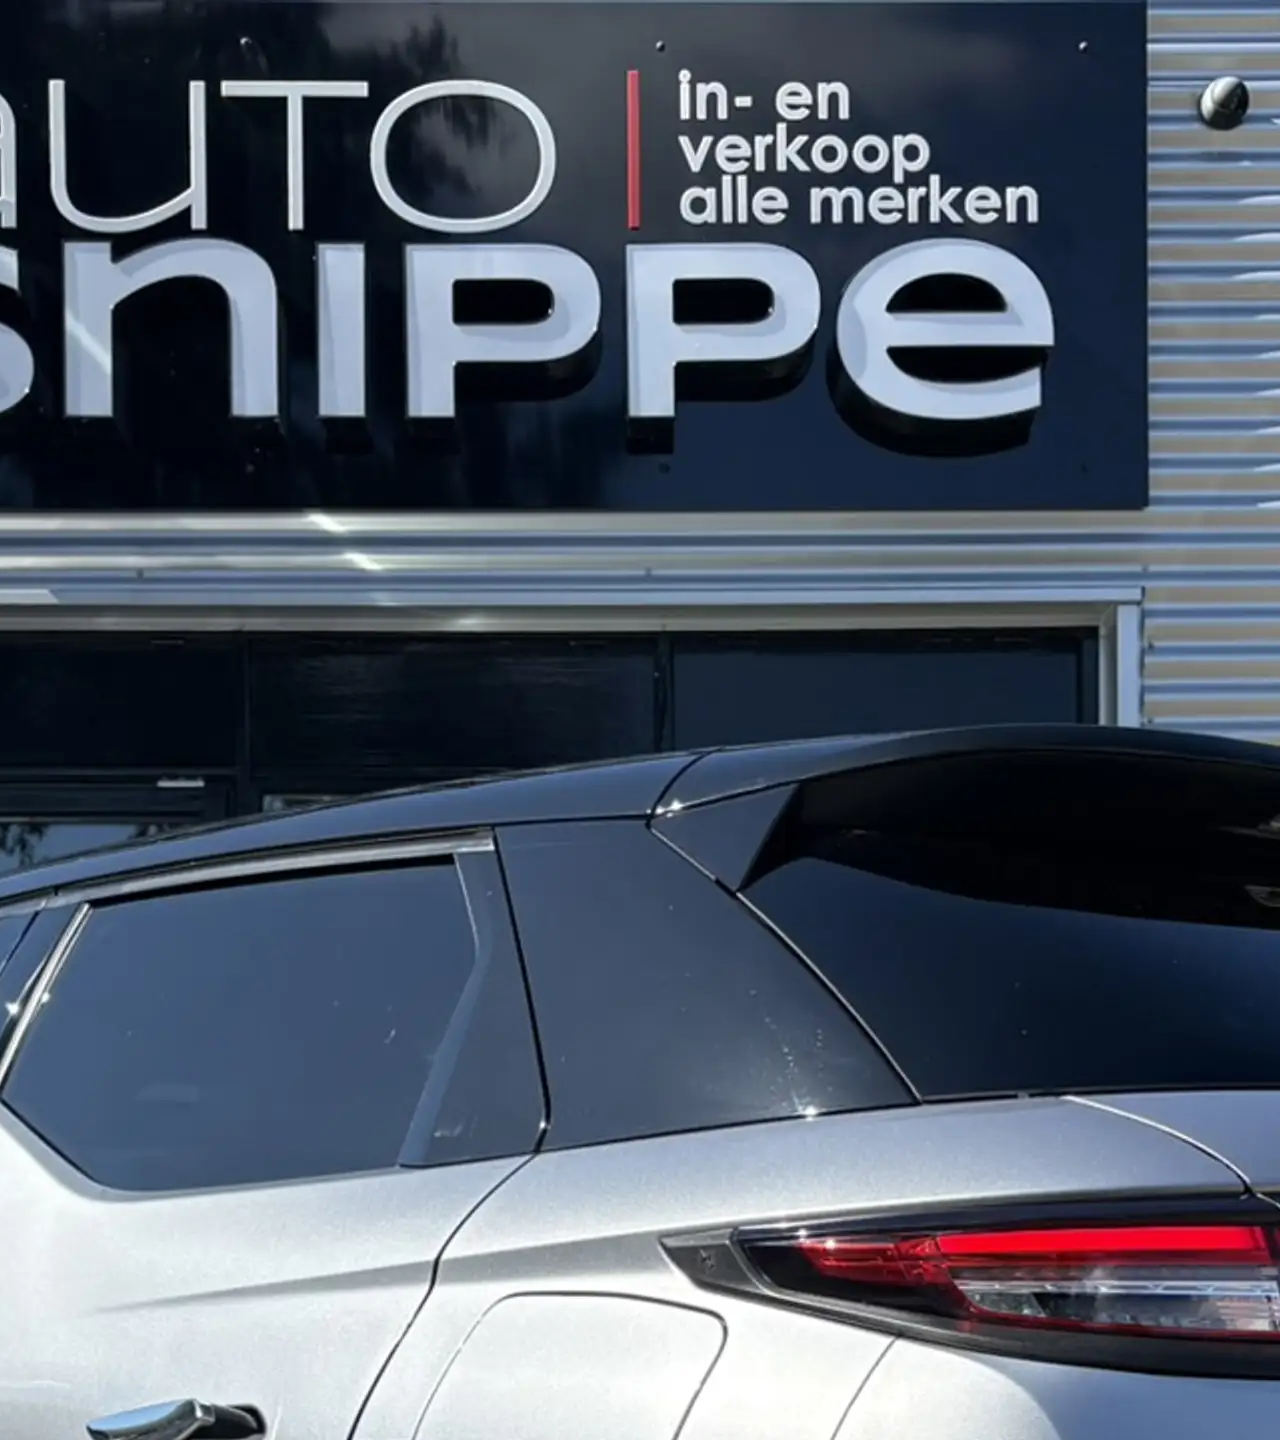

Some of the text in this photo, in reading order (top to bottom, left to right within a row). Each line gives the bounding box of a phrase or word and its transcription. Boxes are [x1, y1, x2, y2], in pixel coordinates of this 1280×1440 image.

[678, 69, 851, 121] in- en
[677, 122, 931, 184] verkoop
[679, 173, 1040, 225] alle merken
